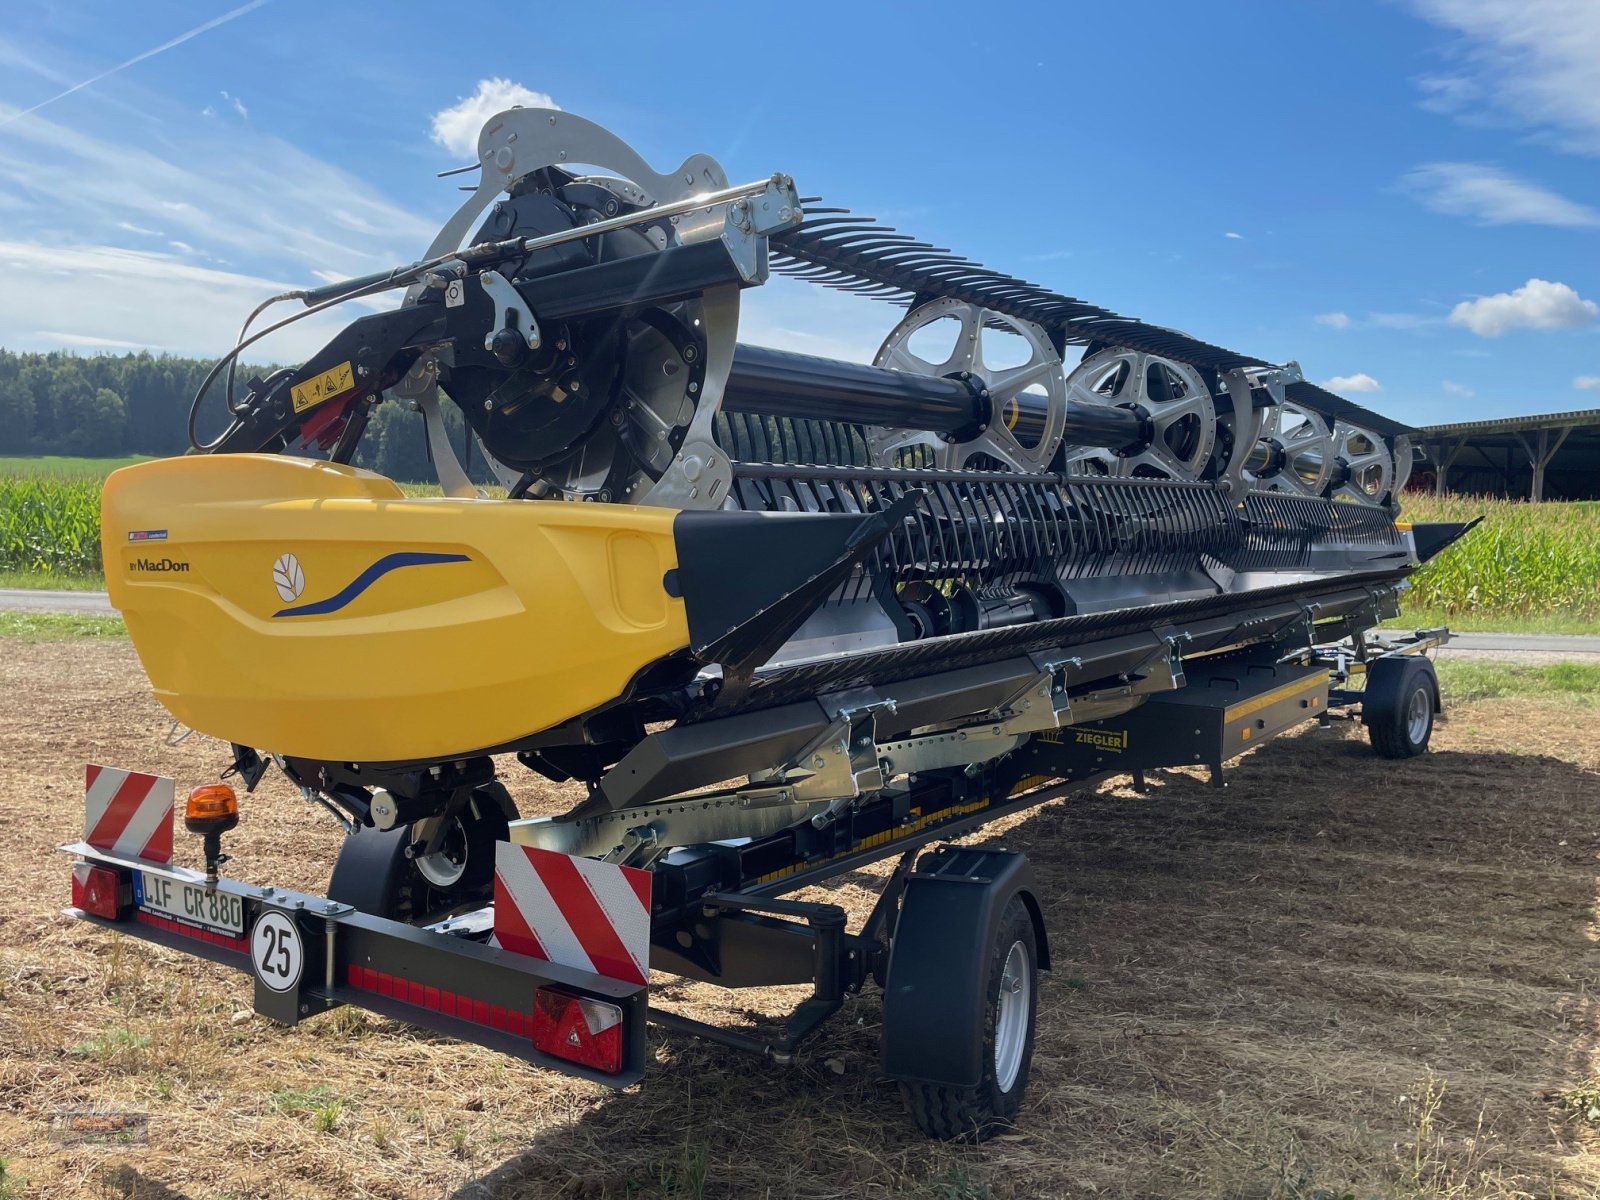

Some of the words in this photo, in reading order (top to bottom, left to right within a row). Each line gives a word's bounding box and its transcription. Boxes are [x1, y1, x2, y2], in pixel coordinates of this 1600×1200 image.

[137, 559, 190, 572] MacDon
[1075, 732, 1121, 748] ZIEGLER
[142, 873, 172, 908] LIF
[183, 885, 206, 919] CR
[208, 893, 241, 929] 880
[261, 924, 292, 979] 25
